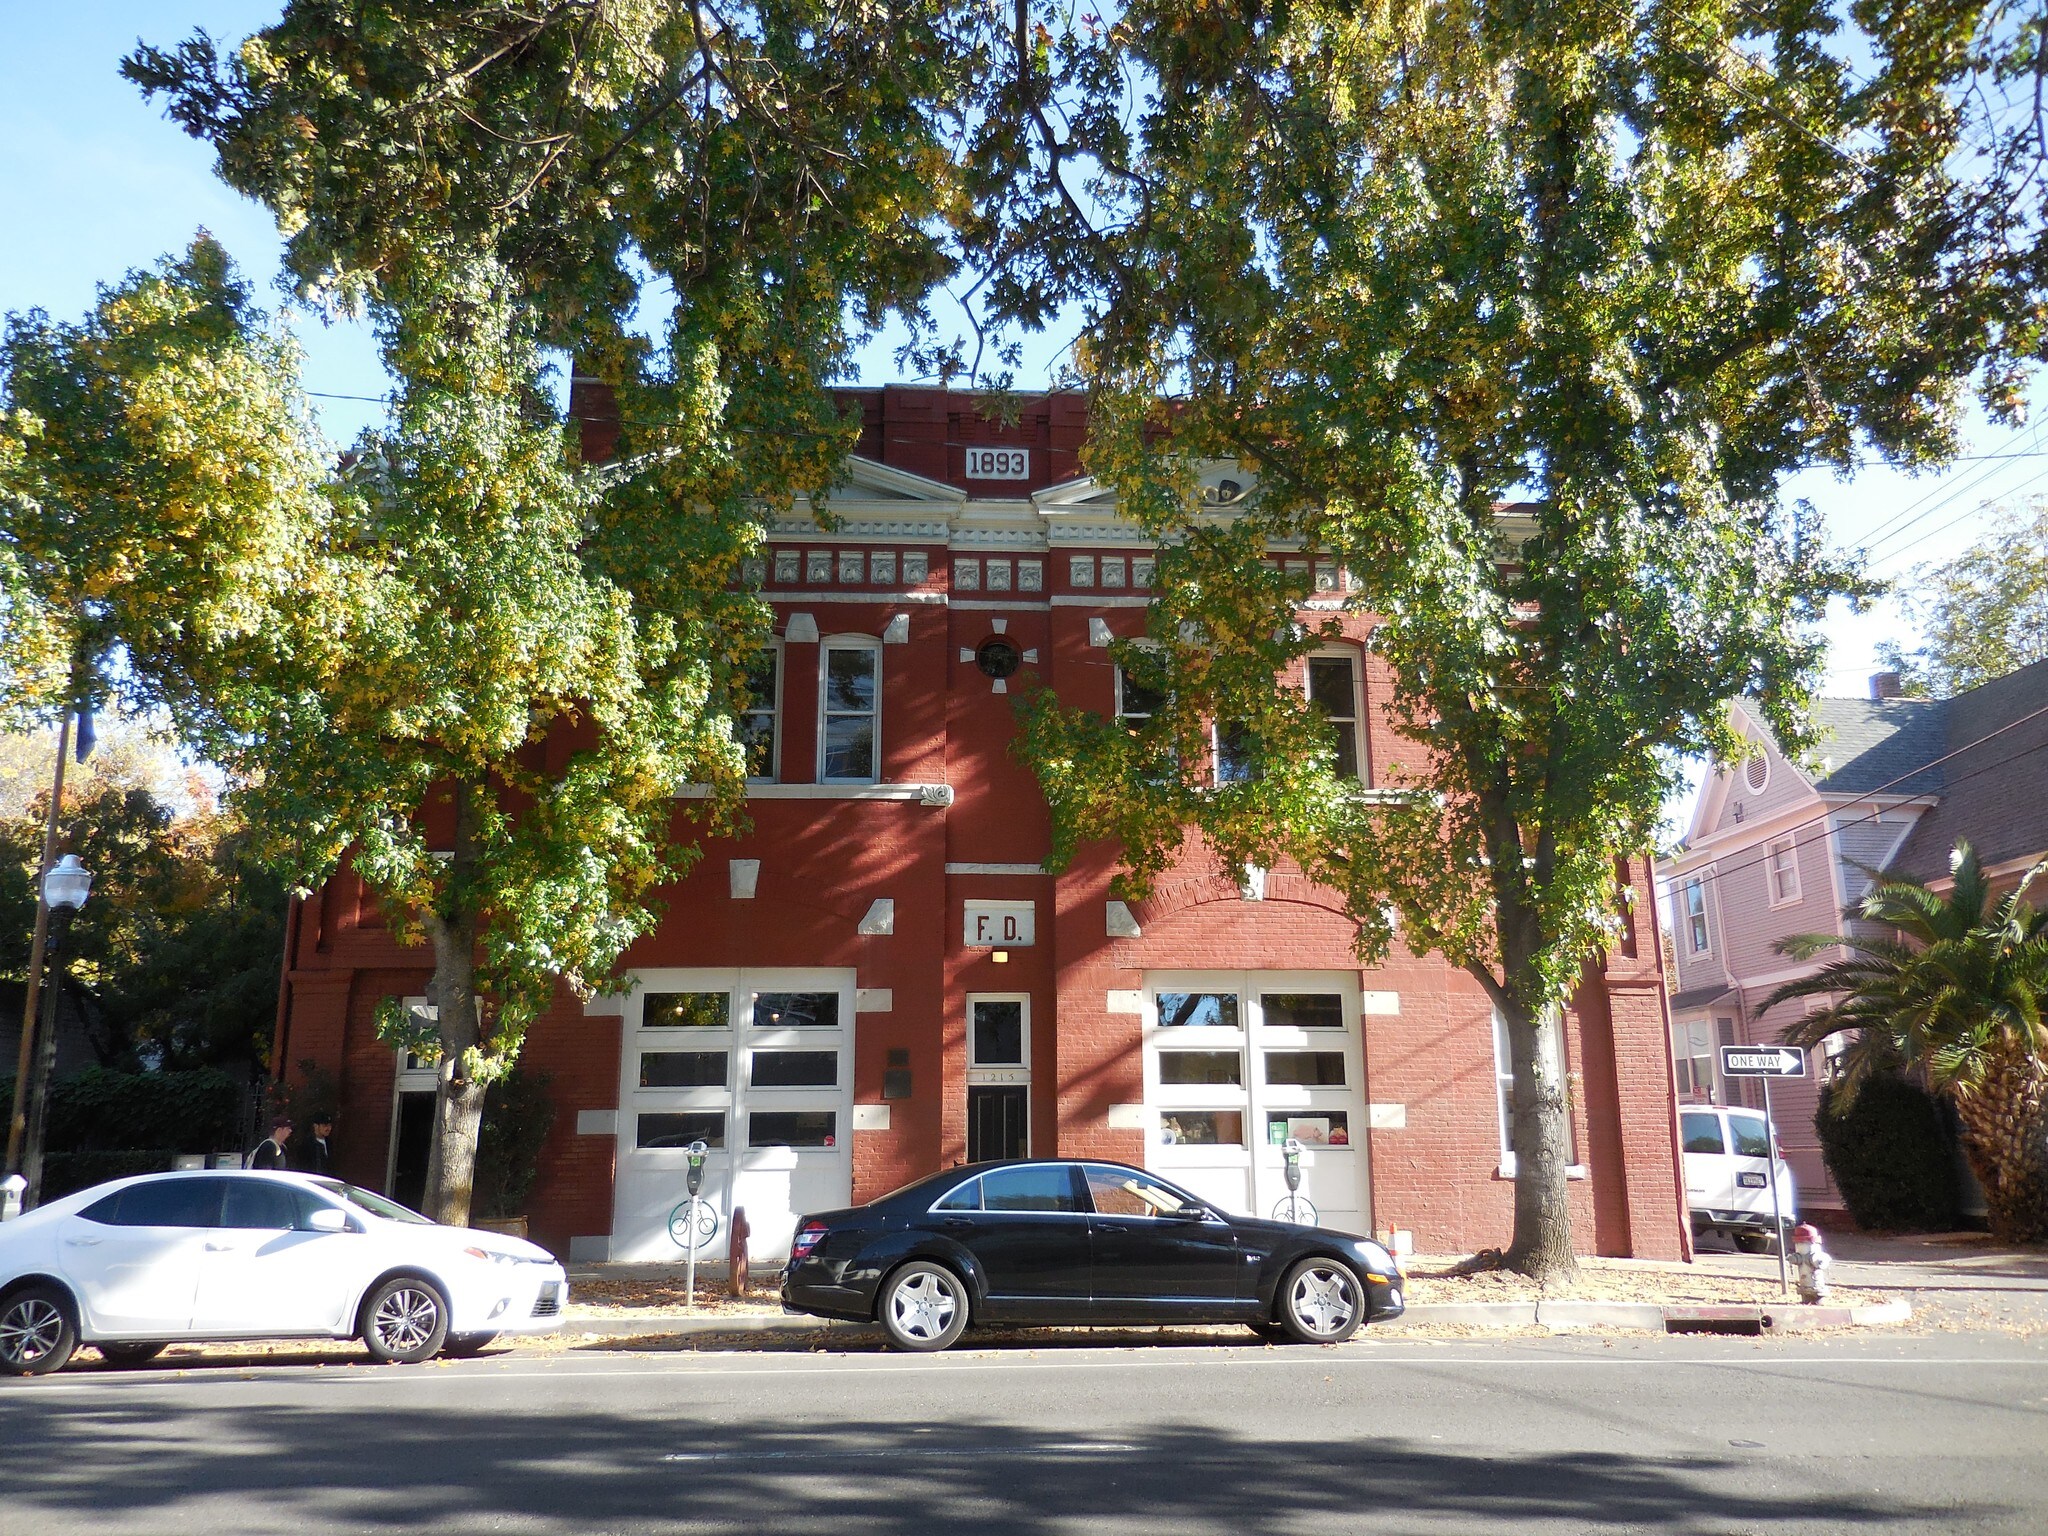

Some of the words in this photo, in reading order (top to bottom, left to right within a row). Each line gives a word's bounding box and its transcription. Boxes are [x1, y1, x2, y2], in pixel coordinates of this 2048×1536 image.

[970, 452, 1024, 475] 1893
[977, 915, 993, 941] F.
[1004, 915, 1022, 941] D.
[1731, 1055, 1754, 1067] ONE
[1757, 1056, 1781, 1067] WAY
[982, 1072, 1015, 1081] 1215
